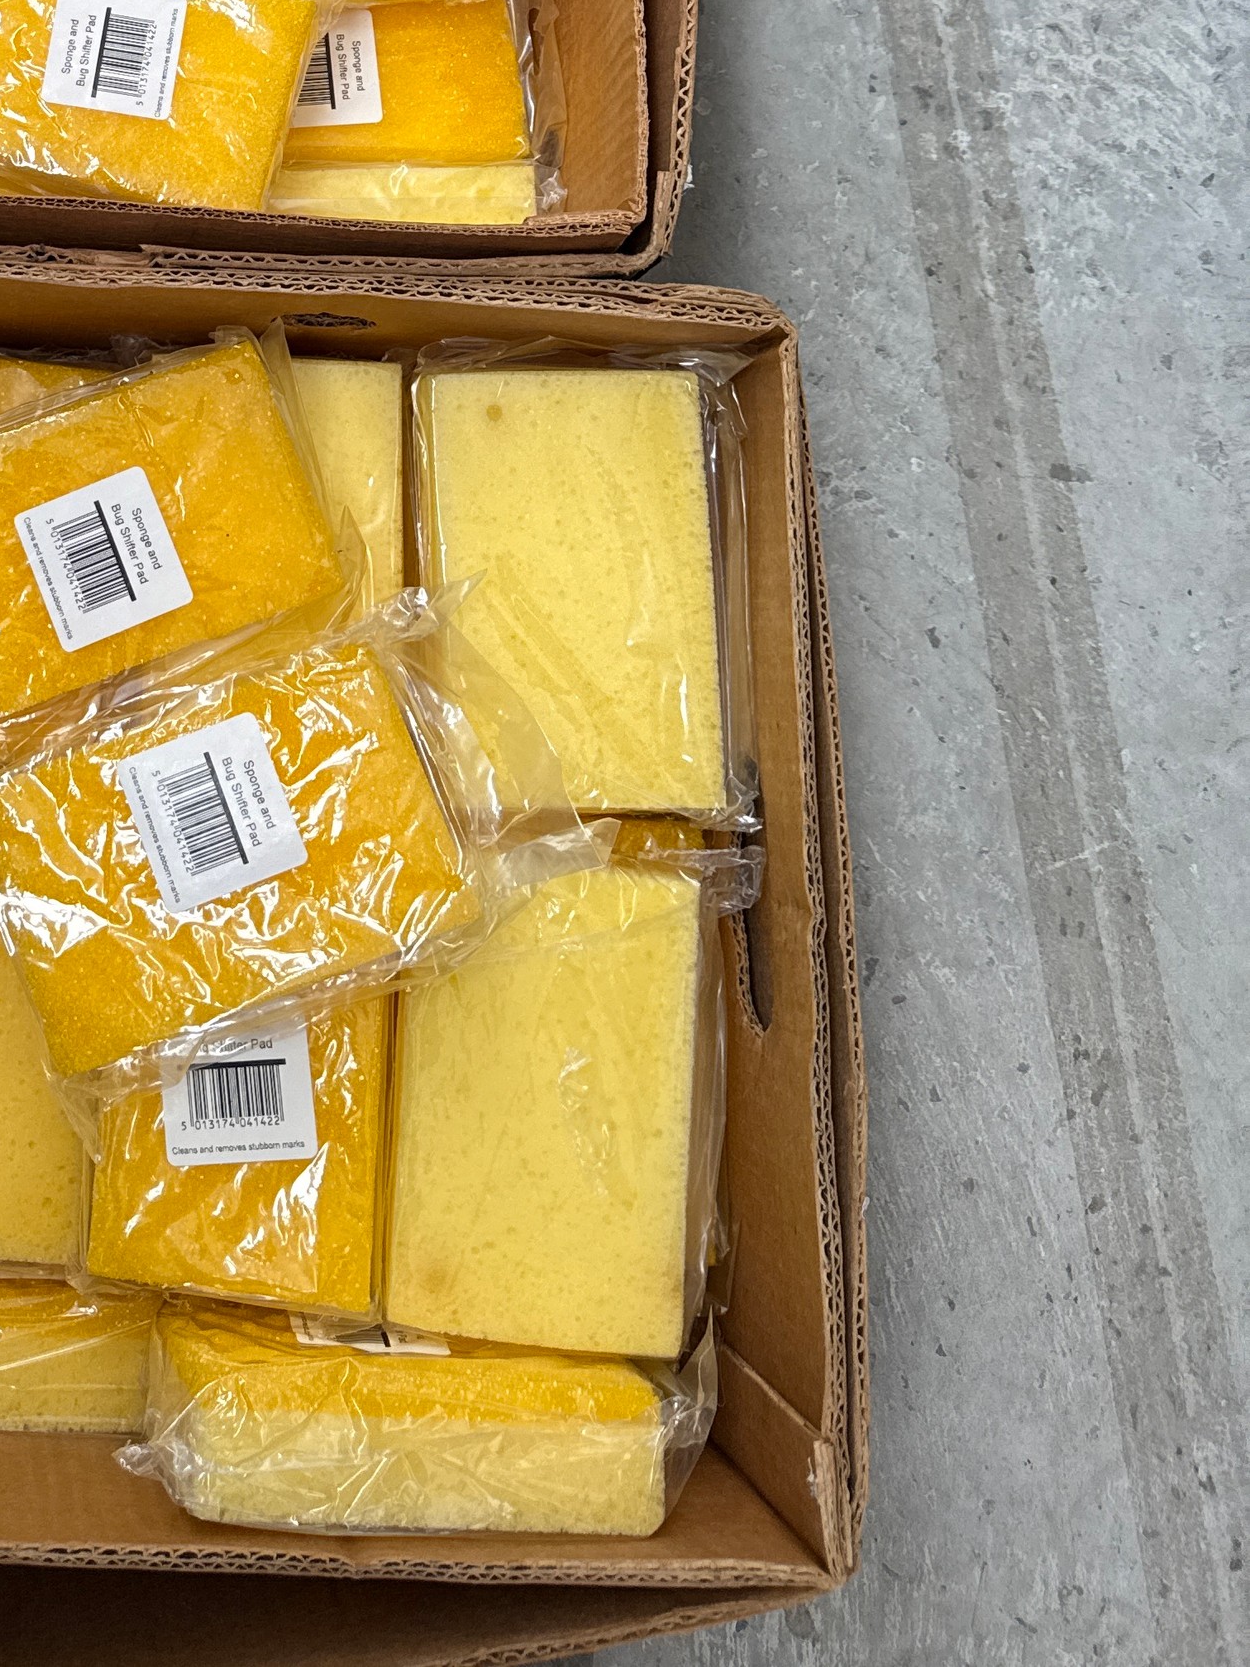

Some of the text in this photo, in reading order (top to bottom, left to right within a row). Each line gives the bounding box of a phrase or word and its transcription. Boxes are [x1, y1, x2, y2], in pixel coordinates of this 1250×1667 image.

[61, 18, 79, 74] Sponge and
[75, 14, 96, 86] Bug Shifter Pad
[138, 60, 150, 94] 013174
[144, 23, 157, 57] 041422
[335, 34, 350, 100] Bug Shifter Pad
[351, 41, 365, 91] Sponge and
[45, 517, 86, 610] 5 013174 041422
[109, 503, 149, 584] Bug Shifter Pad
[129, 507, 162, 570] Sponge and
[151, 769, 194, 872] 5 013174 041422
[219, 756, 262, 847] Bug Shifter Pad
[240, 759, 276, 829] Sponge and
[251, 1037, 272, 1049] Pad
[181, 1116, 280, 1130] 5 013174 041422
